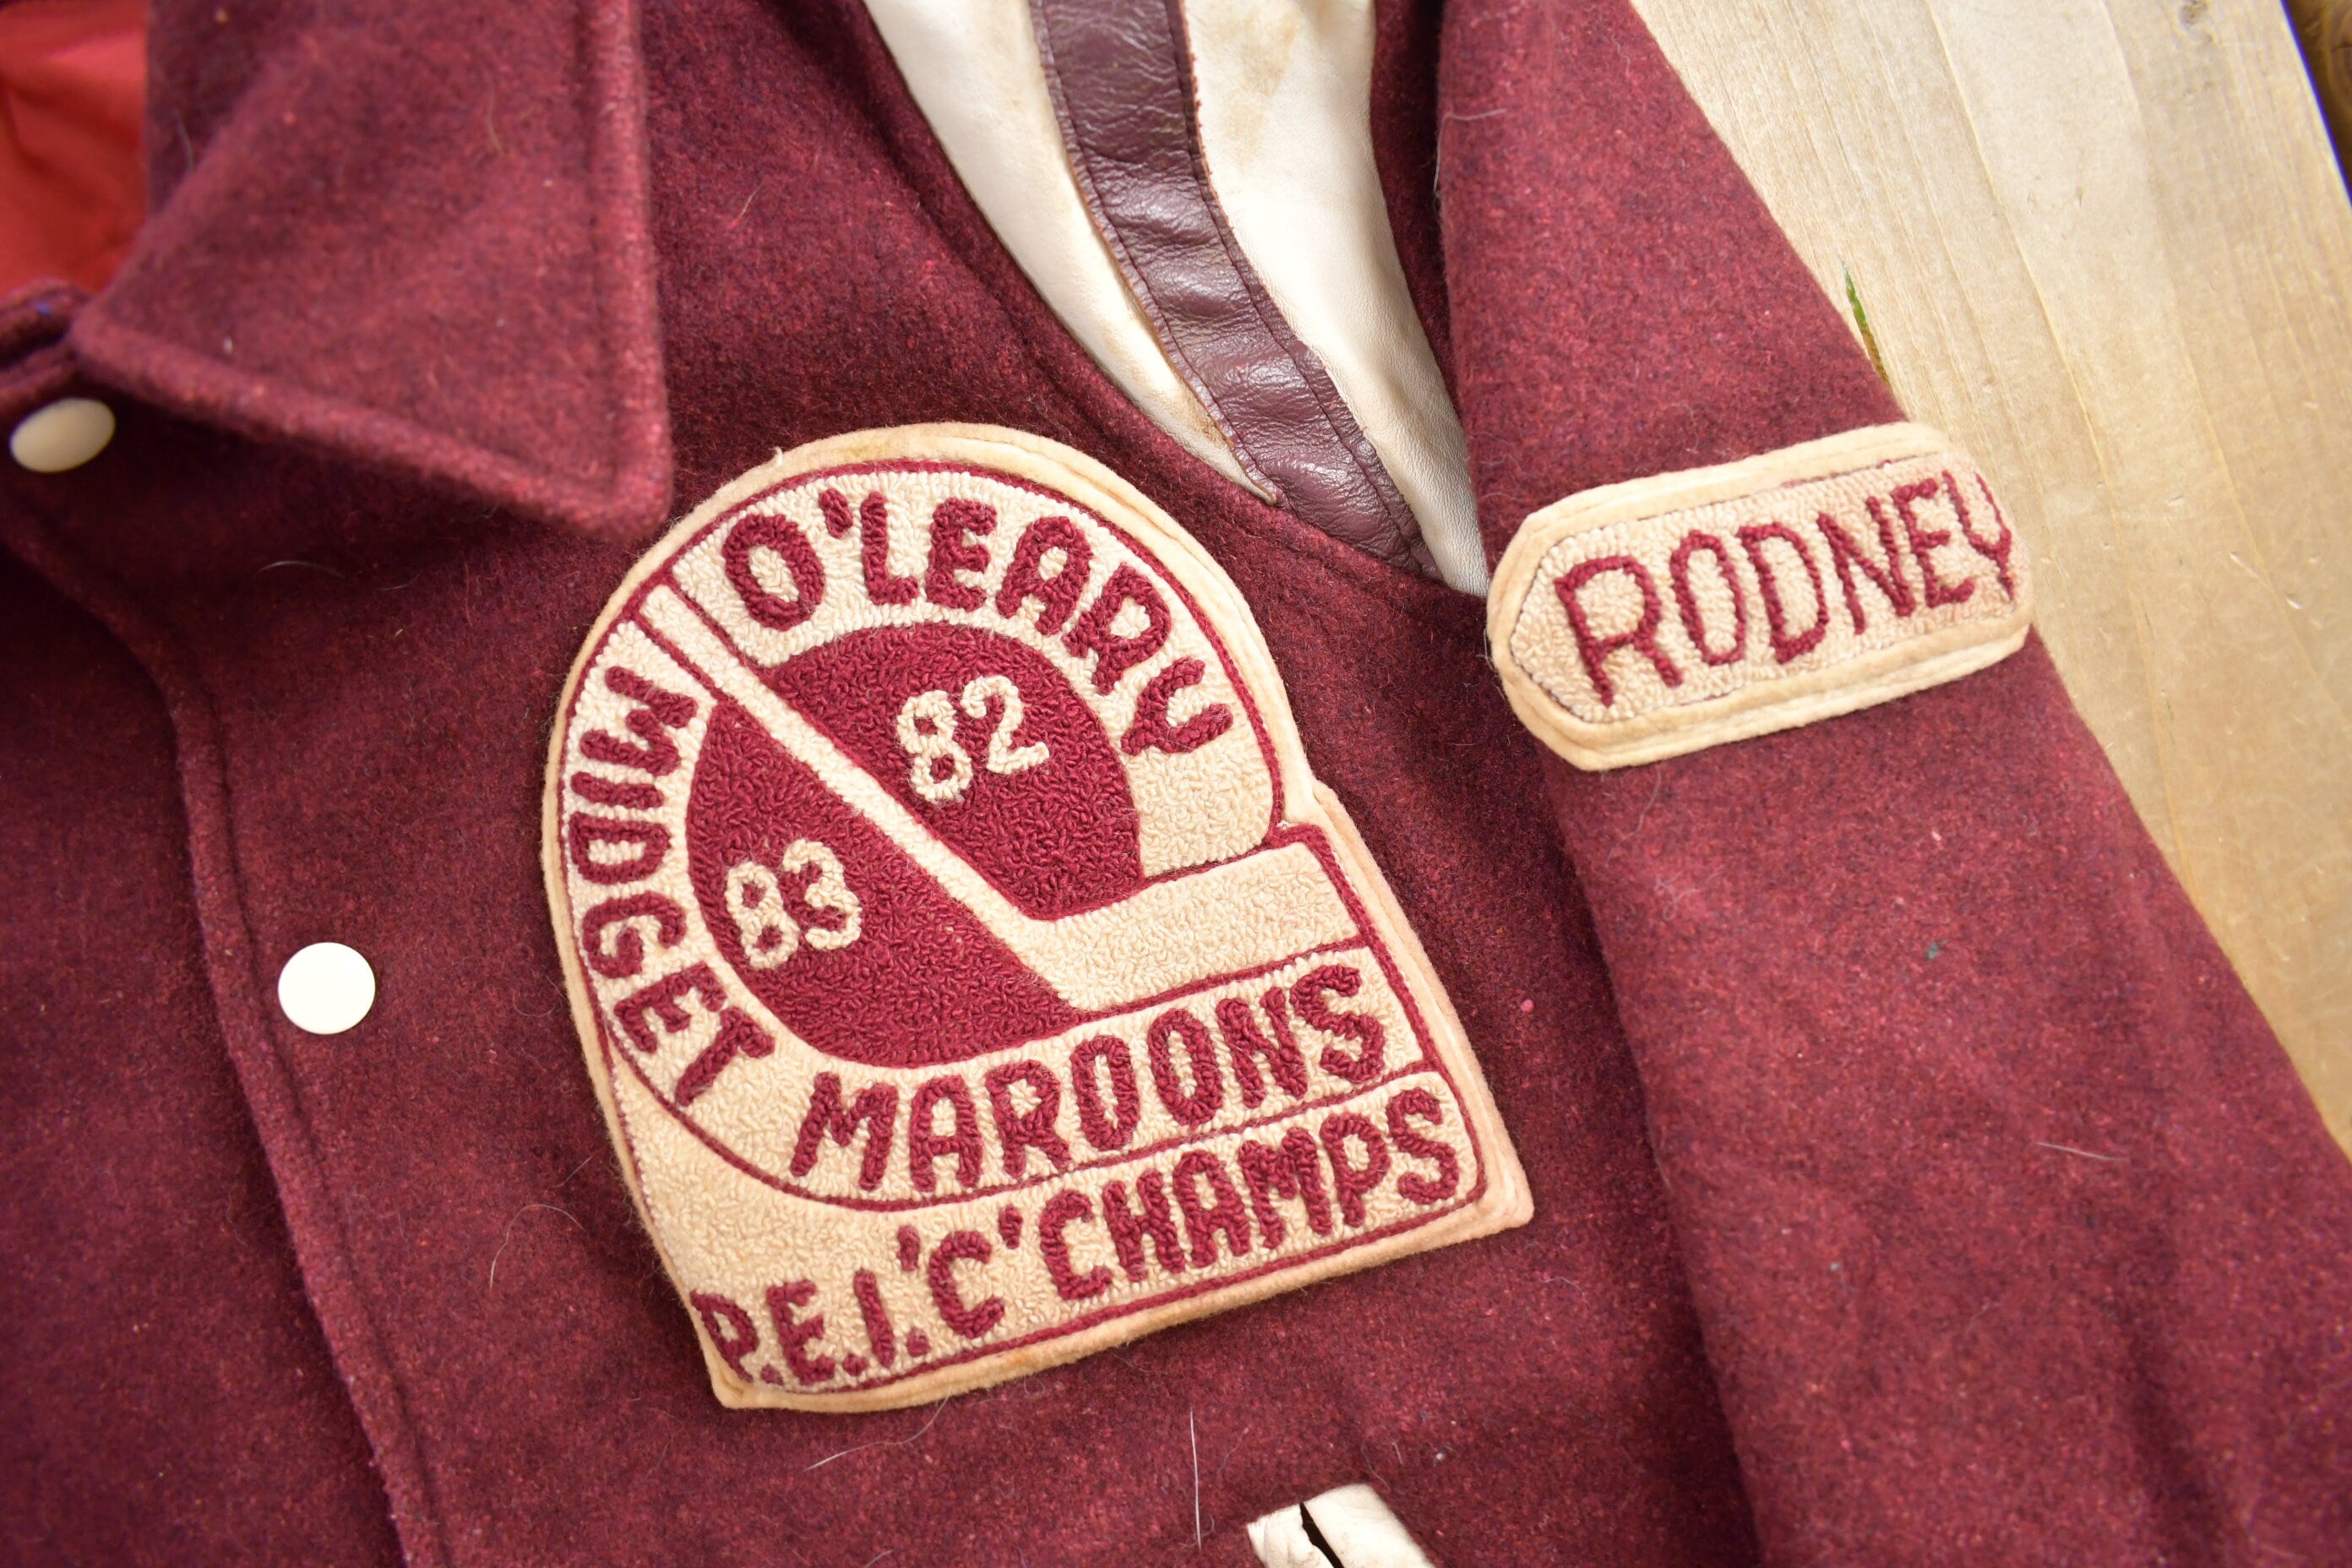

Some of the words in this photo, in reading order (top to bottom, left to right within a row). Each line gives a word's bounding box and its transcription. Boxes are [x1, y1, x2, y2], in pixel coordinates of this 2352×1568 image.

[721, 488, 1233, 757] O'LEARY
[1554, 471, 2012, 706] RODNEY
[895, 674, 1048, 803] 82
[569, 665, 776, 1107] MIDGET
[789, 963, 1386, 1191] MAROONS
[724, 838, 863, 970] 83
[689, 1270, 931, 1386] P.E.I.
[1039, 1086, 1460, 1301] CHAMPS
